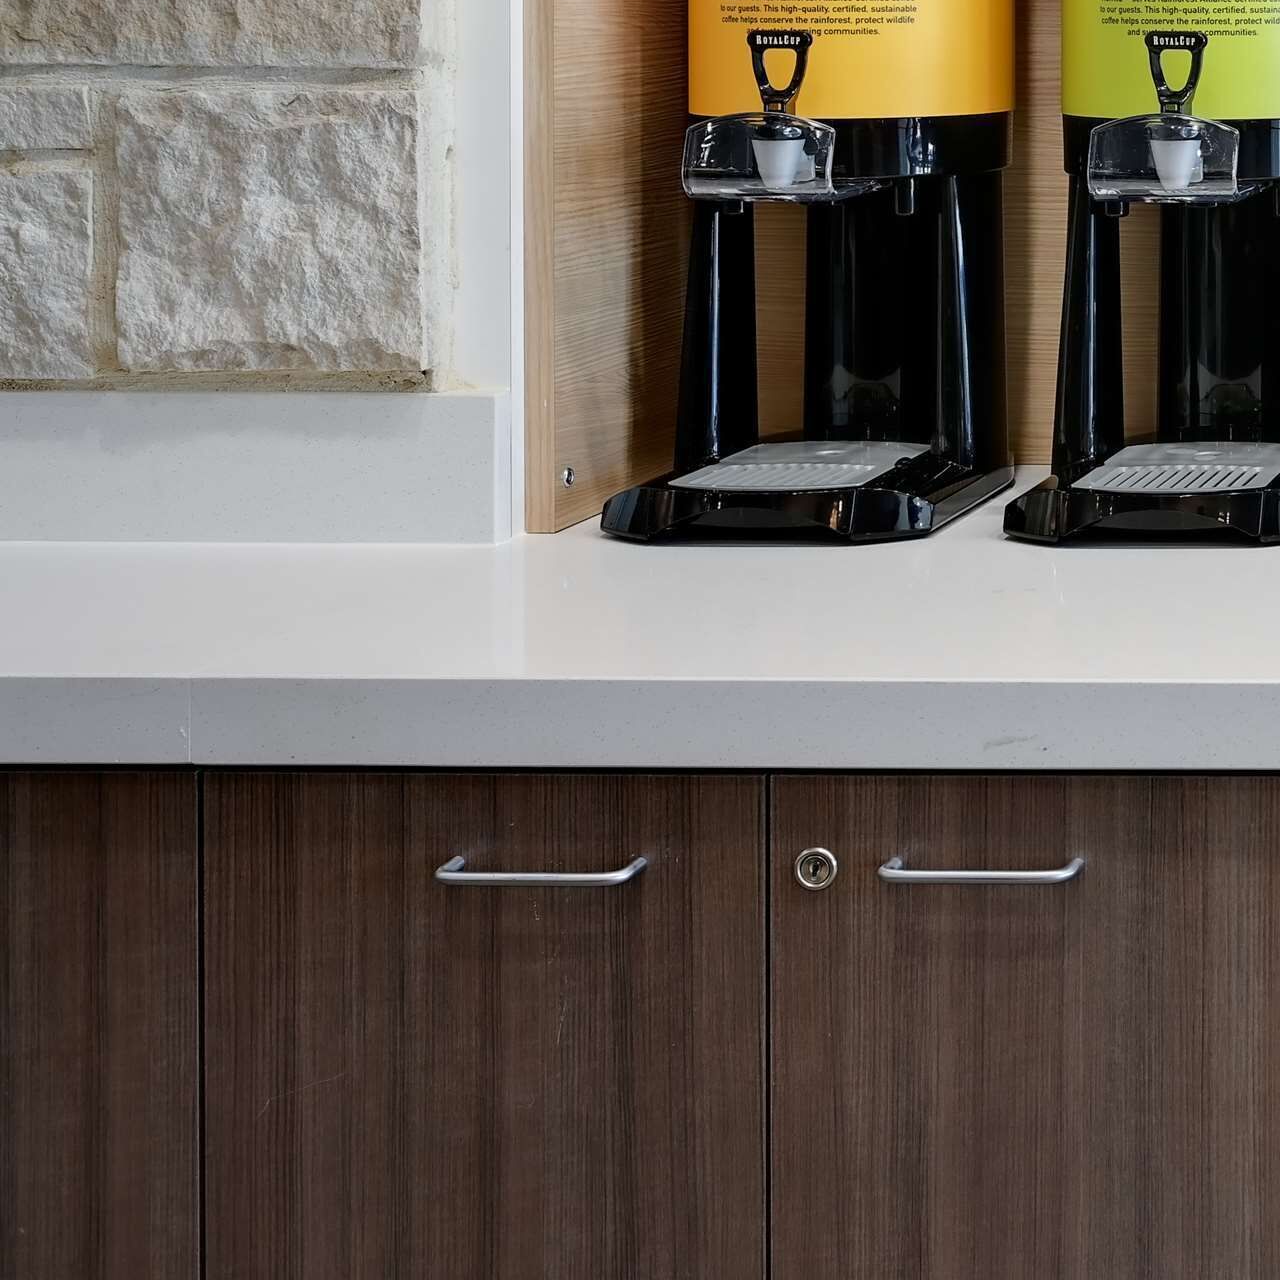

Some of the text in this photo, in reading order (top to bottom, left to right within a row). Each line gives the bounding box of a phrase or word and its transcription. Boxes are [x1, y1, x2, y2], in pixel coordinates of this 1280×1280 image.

[763, 4, 779, 12] This
[740, 16, 758, 24] helps
[855, 17, 884, 25] protect
[1121, 17, 1139, 26] helps
[1234, 17, 1262, 26] protect
[1127, 28, 1140, 36] and
